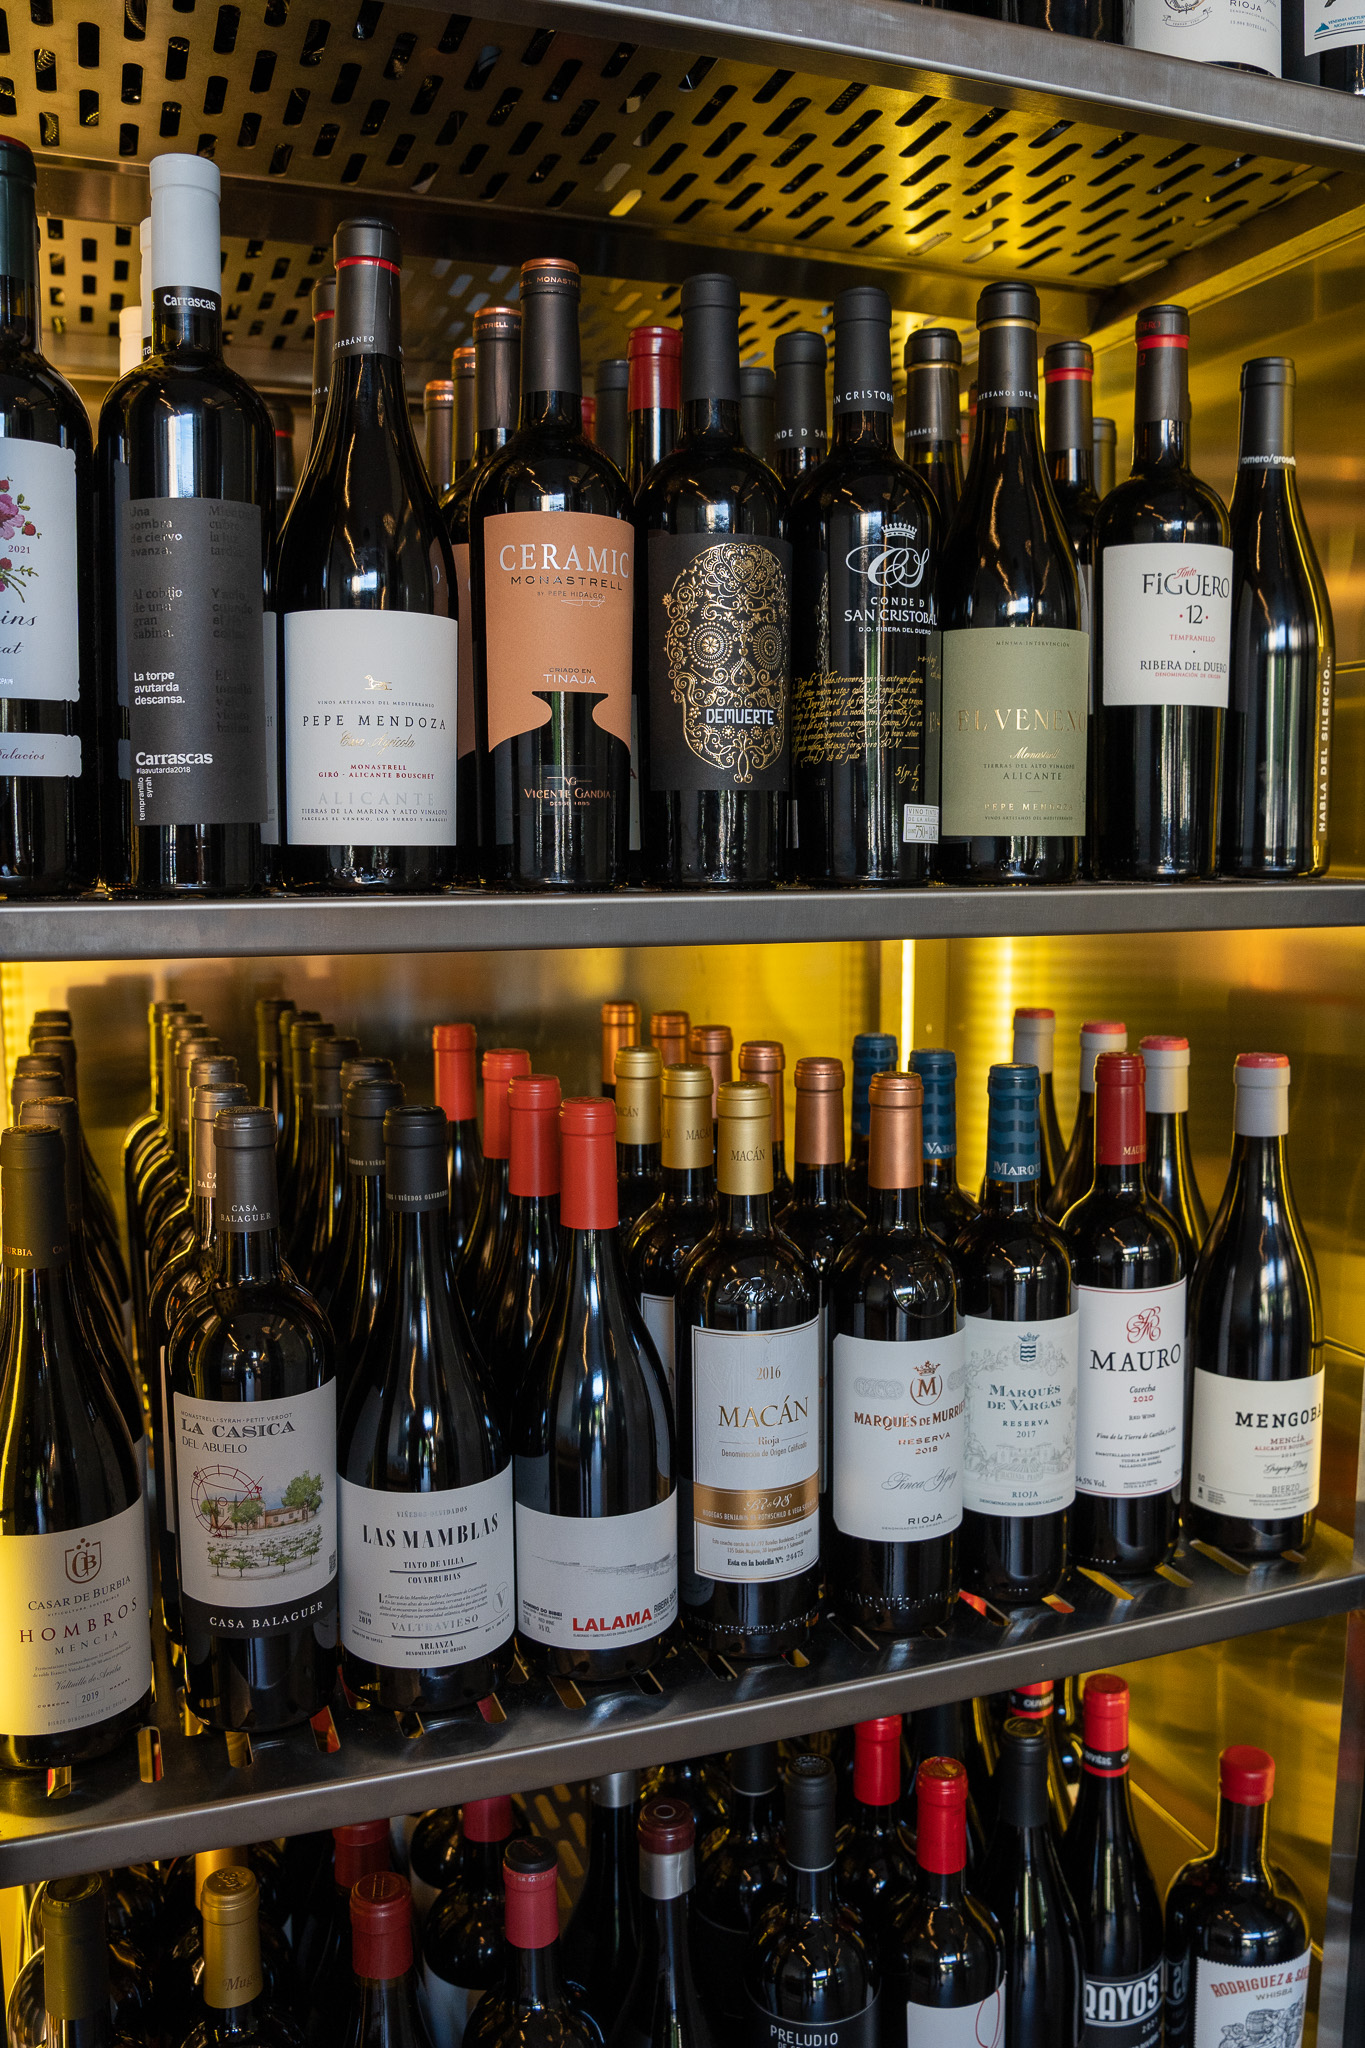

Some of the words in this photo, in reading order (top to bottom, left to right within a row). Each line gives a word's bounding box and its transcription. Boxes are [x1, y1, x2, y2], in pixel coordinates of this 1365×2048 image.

[1229, 0, 1262, 12] RIOJA
[163, 294, 216, 311] Carrascas
[1019, 390, 1032, 398] DEL
[130, 520, 172, 530] sombra
[145, 533, 182, 542] ciervo
[8, 544, 31, 554] 2021
[131, 547, 172, 556] avanza.
[499, 543, 629, 578] CERAMIC
[1174, 567, 1197, 579] Tinto
[510, 576, 623, 590] MONASTRELL
[146, 587, 182, 600] cobijo
[571, 591, 603, 599] HIDALGO
[871, 597, 915, 606] CONDE
[844, 609, 874, 622] SAN
[880, 610, 937, 625] CRISTOBAL
[1186, 604, 1202, 624] 12
[134, 628, 174, 639] sabina.
[1169, 634, 1215, 642] TEMPRANILLO
[1140, 660, 1182, 671] RIBERA
[1185, 662, 1202, 671] DEL
[1203, 662, 1227, 673] DUERO
[134, 672, 144, 681] La
[146, 672, 174, 682] torpe
[543, 674, 596, 684] TINAJA
[135, 683, 179, 693] avutarda
[135, 696, 185, 705] descansa.
[1321, 655, 1332, 758] SILENCIO...
[303, 715, 344, 726] PEPE
[358, 715, 446, 730] MENDOZA
[706, 708, 774, 725] DEMUERTE
[958, 709, 987, 731] EL
[136, 752, 213, 765] Carrascas
[1003, 772, 1062, 780] ALICANTE
[1320, 762, 1328, 785] DEL
[319, 792, 434, 806] ALICANTE
[524, 788, 571, 799] VICENTE
[984, 803, 1014, 811] PEPE
[1318, 789, 1326, 832] HABLA
[731, 1146, 765, 1161] MACÁN
[231, 1204, 258, 1212] CASA
[220, 1211, 271, 1223] BALAGUER
[1090, 1344, 1180, 1372] MAURO
[756, 1364, 781, 1380] 2016
[989, 1384, 1061, 1398] MARQUÉS
[1130, 1384, 1156, 1393] Cosecha
[987, 1401, 1005, 1410] DE
[1008, 1398, 1062, 1411] VARGAS
[266, 1412, 292, 1421] VERDOT
[718, 1395, 809, 1428] MACÁN
[854, 1411, 917, 1431] MARQUÉS
[919, 1416, 930, 1426] DE
[181, 1418, 204, 1435] LA
[212, 1419, 296, 1439] CASICA
[182, 1436, 199, 1450] DEL
[202, 1442, 247, 1454] ABUELO
[758, 1435, 780, 1446] Rioja
[898, 1432, 951, 1445] RESERVA
[1270, 1433, 1305, 1445] MENCÍA
[722, 1449, 760, 1457] Denominación
[762, 1449, 768, 1457] de
[770, 1447, 786, 1456] Origen
[915, 1446, 938, 1455] 2018
[881, 1471, 924, 1491] Finca
[1272, 1483, 1299, 1493] BIERZO
[792, 1506, 802, 1514] VEGA
[908, 1514, 943, 1525] RIOJA
[363, 1524, 396, 1548] LAS
[402, 1512, 498, 1549] MAMBLAS
[403, 1560, 427, 1569] TINTO
[430, 1560, 440, 1568] DE
[443, 1556, 464, 1566] VILLA
[756, 1558, 774, 1566] botella
[408, 1572, 461, 1584] COVARRUBIAS
[28, 1598, 70, 1611] CASAR
[74, 1593, 90, 1604] DE
[93, 1575, 130, 1598] BURBIA
[653, 1597, 669, 1613] RIBEIRA
[19, 1597, 137, 1642] HOMBROS
[210, 1616, 244, 1629] CASA
[253, 1601, 323, 1628] BALAGUER
[358, 1614, 372, 1626] 2019
[572, 1608, 652, 1631] LALAMA
[391, 1613, 479, 1632] VALTRAVIESO
[54, 1630, 118, 1655] MENCIA
[420, 1639, 454, 1650] ARLANZA
[82, 1691, 99, 1703] 2019
[1211, 1974, 1283, 1997] RODRIGUEZ
[1285, 1973, 1293, 1983] &
[1085, 1973, 1159, 2021] RAYOS
[1256, 1988, 1292, 2001] WHISBA
[771, 2025, 838, 2046] PRELUDIO
